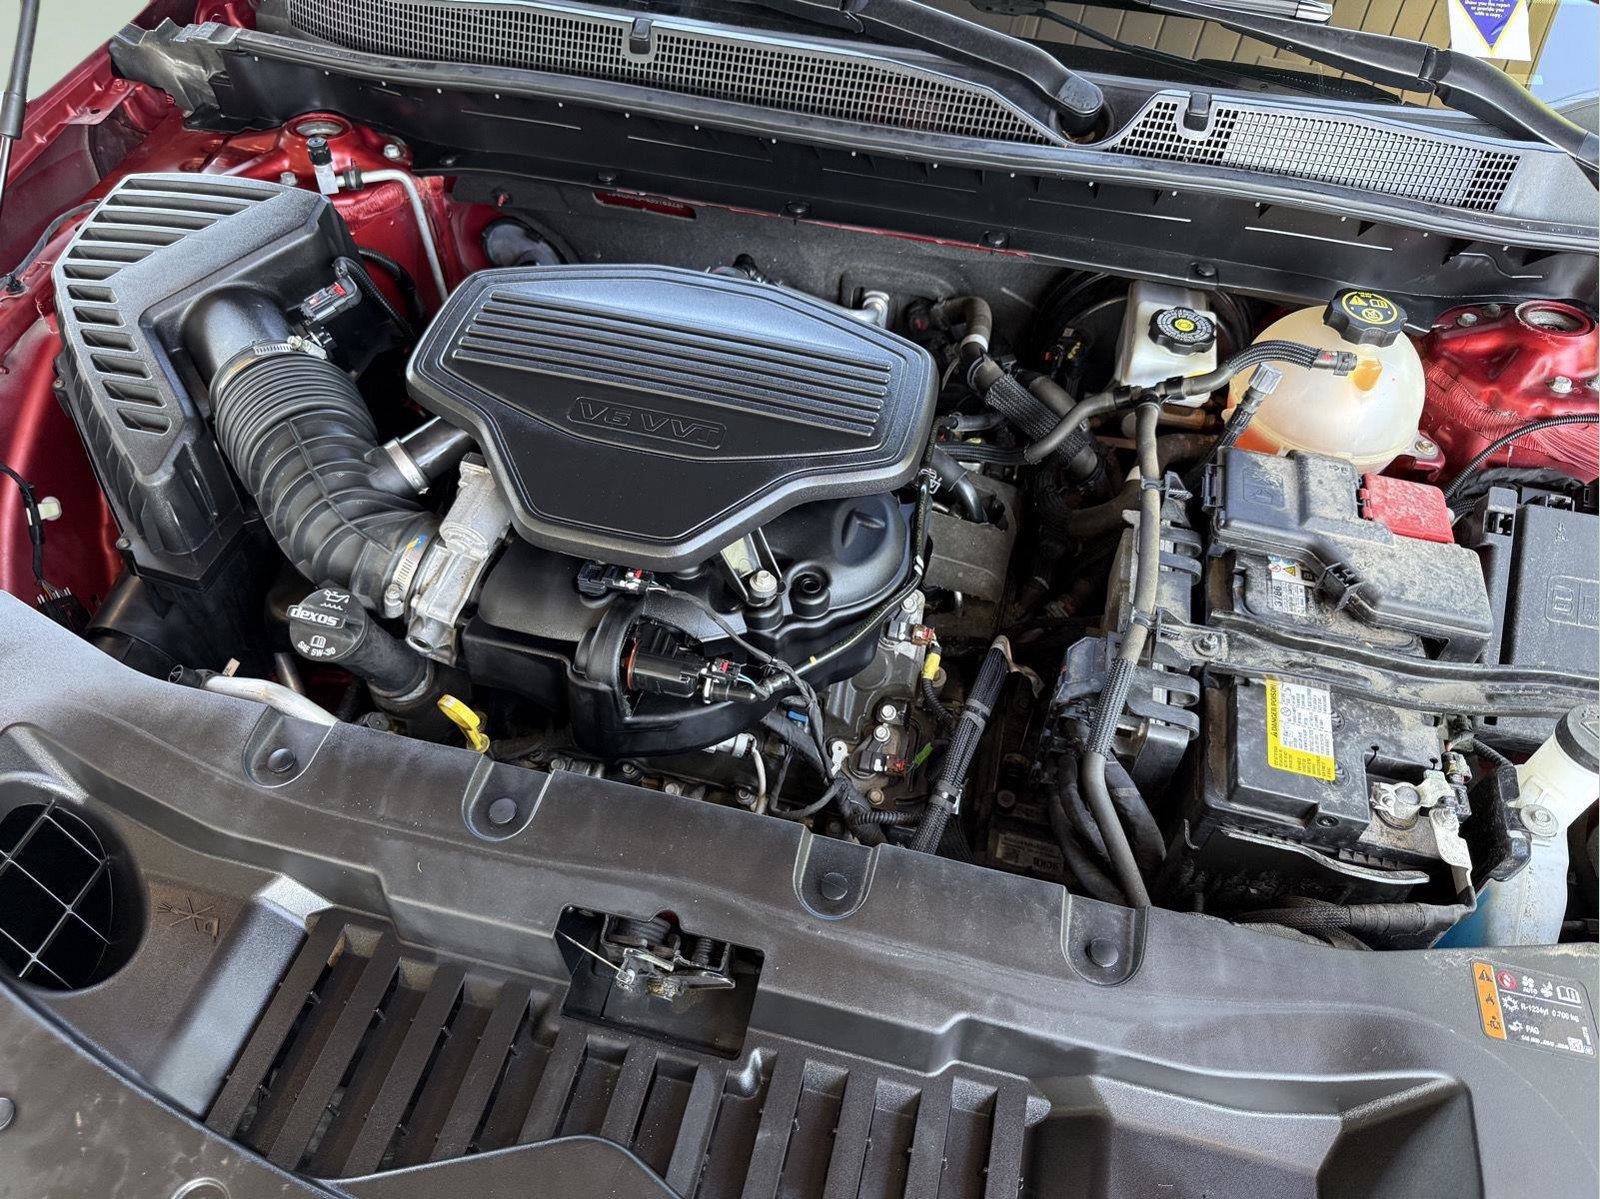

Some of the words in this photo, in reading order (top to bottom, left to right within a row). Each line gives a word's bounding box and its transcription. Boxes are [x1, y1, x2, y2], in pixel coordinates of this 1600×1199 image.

[580, 401, 633, 427] V6
[640, 413, 721, 443] VVT
[290, 606, 340, 627] dexos
[298, 640, 311, 654] SAE
[311, 646, 337, 657] 5W-30
